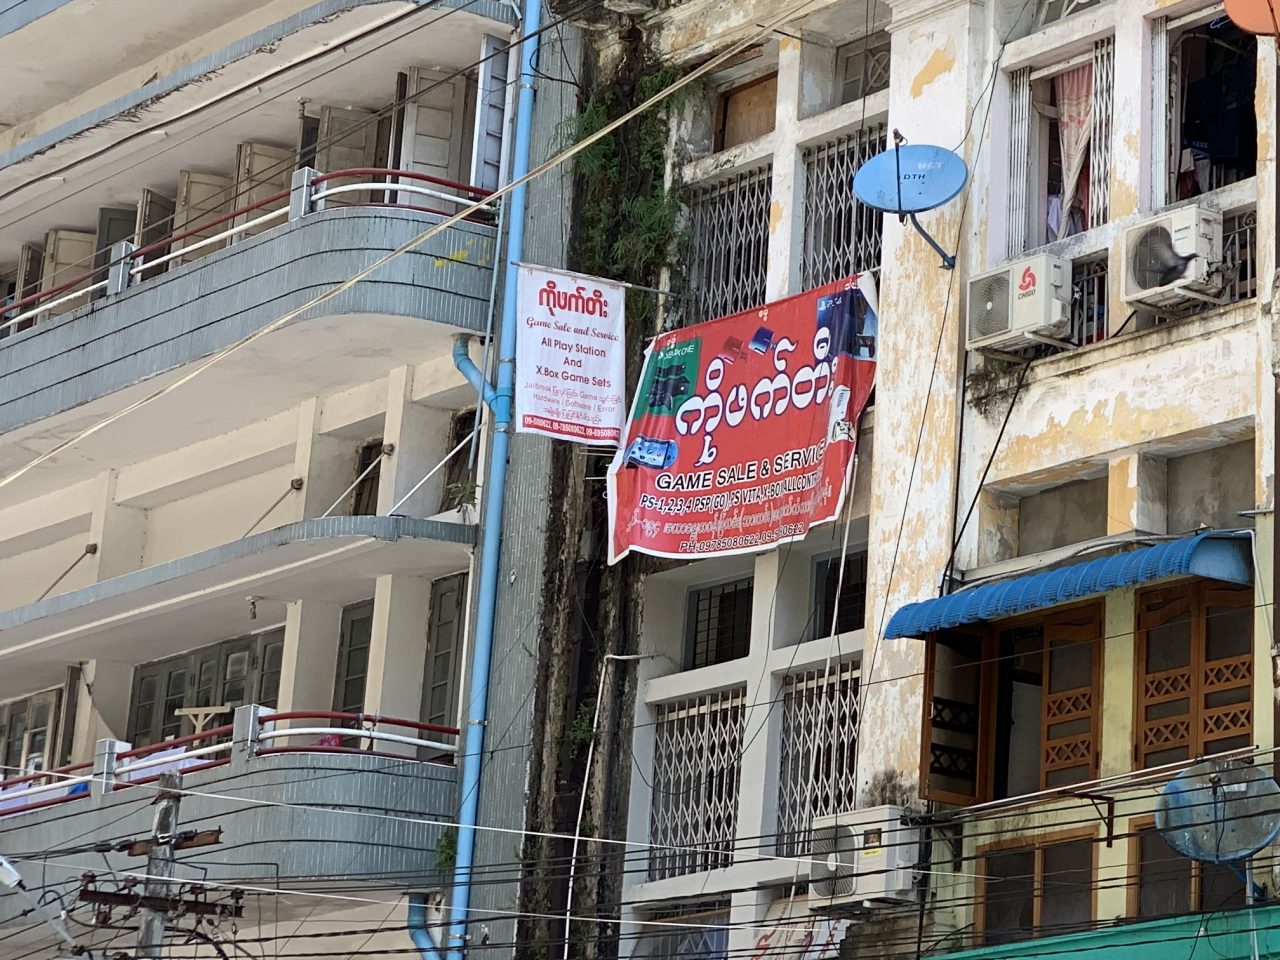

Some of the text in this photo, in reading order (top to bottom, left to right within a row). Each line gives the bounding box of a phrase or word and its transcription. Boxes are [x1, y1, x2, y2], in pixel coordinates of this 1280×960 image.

[903, 173, 926, 181] DTH
[1017, 289, 1037, 300] CHIGO
[526, 317, 620, 341] Game Sale and Service
[541, 337, 606, 357] All Play Station
[563, 357, 582, 367] And
[536, 365, 612, 388] X.Box Game Sets
[597, 404, 616, 413] Error
[656, 472, 713, 491] GAME
[717, 462, 757, 486] SALE
[760, 459, 772, 477] &
